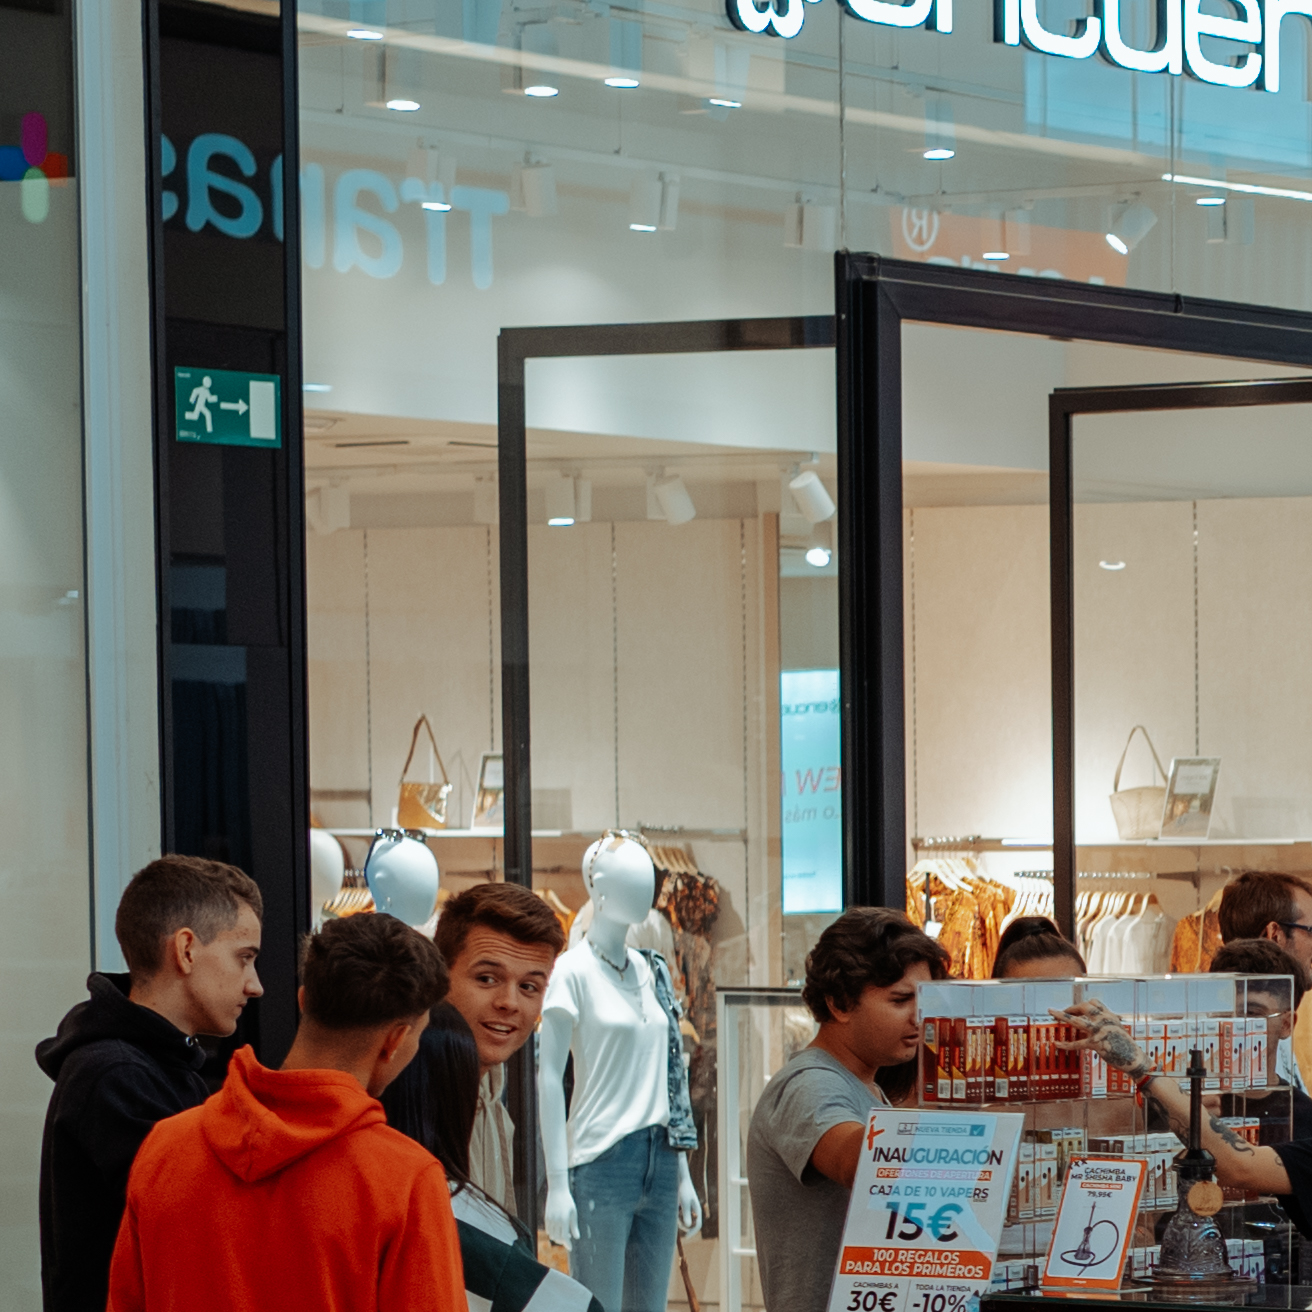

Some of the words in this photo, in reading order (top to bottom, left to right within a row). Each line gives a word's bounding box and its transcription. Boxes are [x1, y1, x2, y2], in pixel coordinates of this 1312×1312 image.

[872, 1145, 1004, 1166] INAUGURACIÓN
[877, 1169, 930, 1178] OFERTONES
[930, 1170, 942, 1179] DE
[943, 1170, 991, 1180] APERTURA
[1084, 1167, 1126, 1175] CACHIMBA
[869, 1184, 900, 1196] CAJA
[904, 1186, 920, 1197] DE
[924, 1186, 937, 1197] 10
[940, 1187, 989, 1199] VAPERS
[885, 1201, 964, 1243] 15€
[873, 1249, 895, 1262] 100
[897, 1250, 960, 1264] REGALOS
[845, 1260, 881, 1274] PARA
[884, 1262, 910, 1275] LOS
[912, 1263, 984, 1278] PRIMEROS
[853, 1281, 892, 1289] CACHIMBAS
[935, 1284, 945, 1292] LA
[946, 1285, 971, 1293] TIENDA
[847, 1290, 898, 1312] 30€
